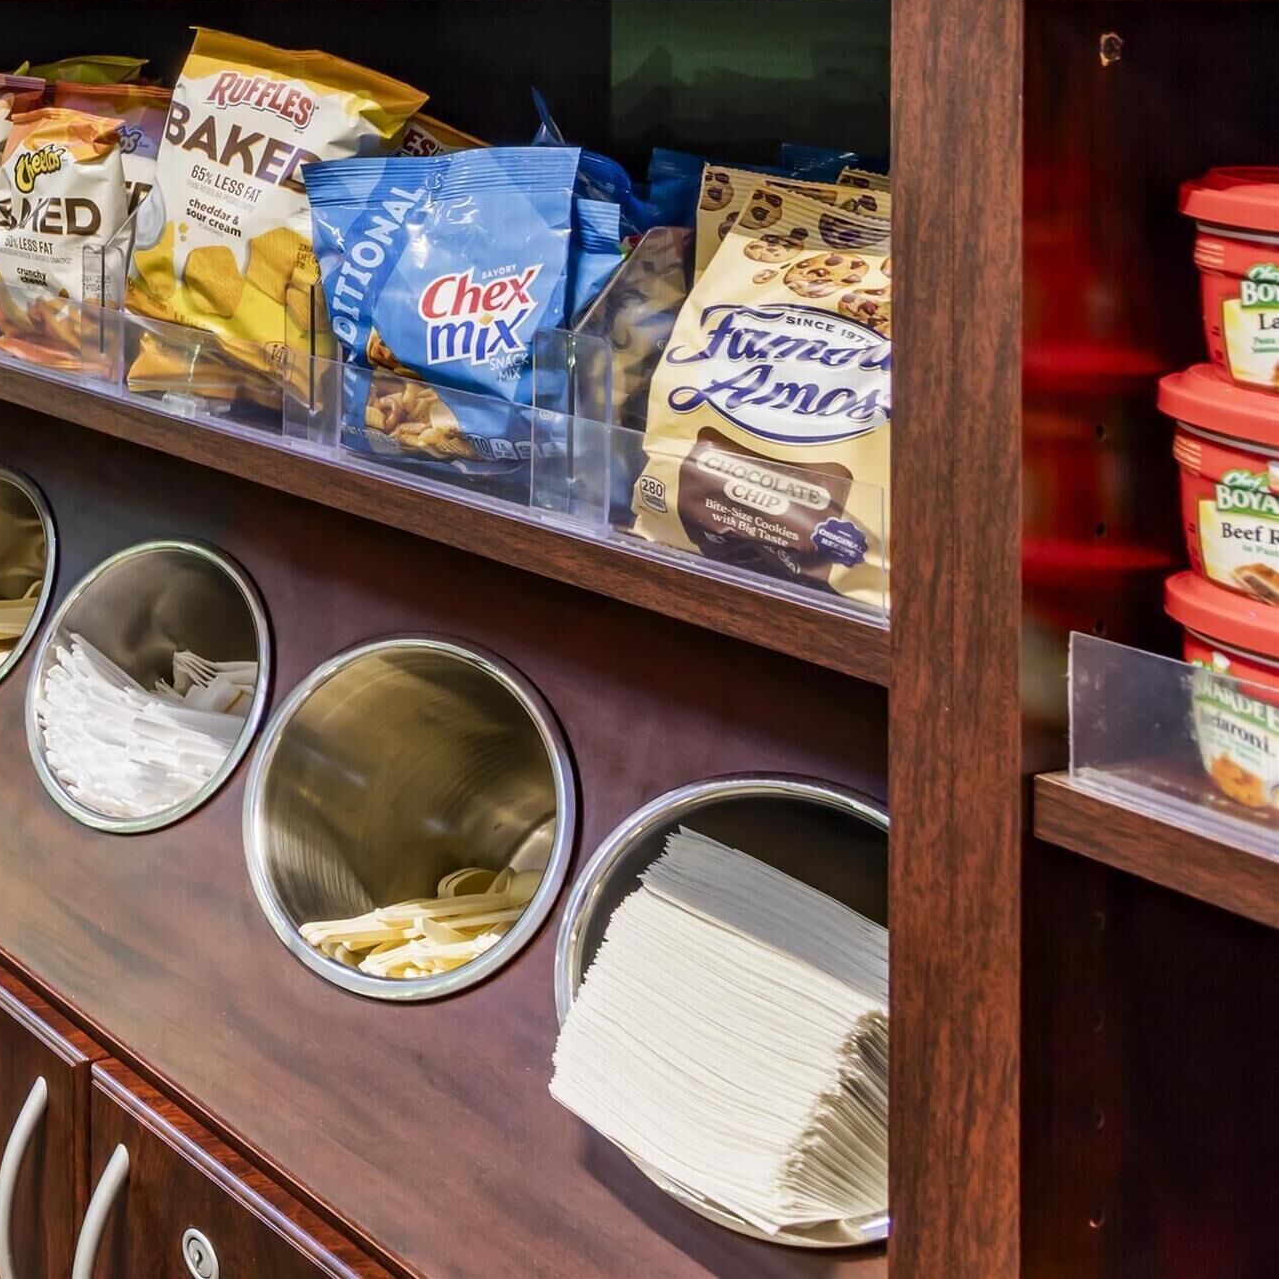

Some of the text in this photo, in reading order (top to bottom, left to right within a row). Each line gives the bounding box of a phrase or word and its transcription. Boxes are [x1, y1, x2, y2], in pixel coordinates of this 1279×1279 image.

[207, 72, 314, 129] RUFFLES
[163, 100, 323, 194] BAKED
[15, 144, 65, 194] Cheetos
[191, 164, 213, 185] 65%
[214, 173, 243, 197] LESS
[243, 187, 262, 204] FAT
[185, 206, 242, 238] sour cream
[188, 197, 240, 226] cheddar &
[18, 238, 54, 255] LESS FAT
[16, 267, 47, 282] crunchy
[481, 264, 518, 280] SAVORY
[333, 186, 427, 396] DITIONAL
[421, 268, 537, 319] Chex
[431, 309, 529, 362] mix
[665, 304, 891, 372] Famou
[785, 315, 836, 334] SINCE
[489, 354, 529, 371] SNACK
[498, 367, 522, 381] MIX
[667, 364, 882, 422] Amos
[641, 477, 665, 498] 280
[704, 456, 821, 505] CHOCOLATE
[732, 484, 782, 509] CHIP
[705, 498, 800, 542] Bite-Size Cookies
[712, 512, 790, 548] with Big Taste
[1221, 521, 1264, 543] Beef
[818, 529, 864, 554] ORIGINAL
